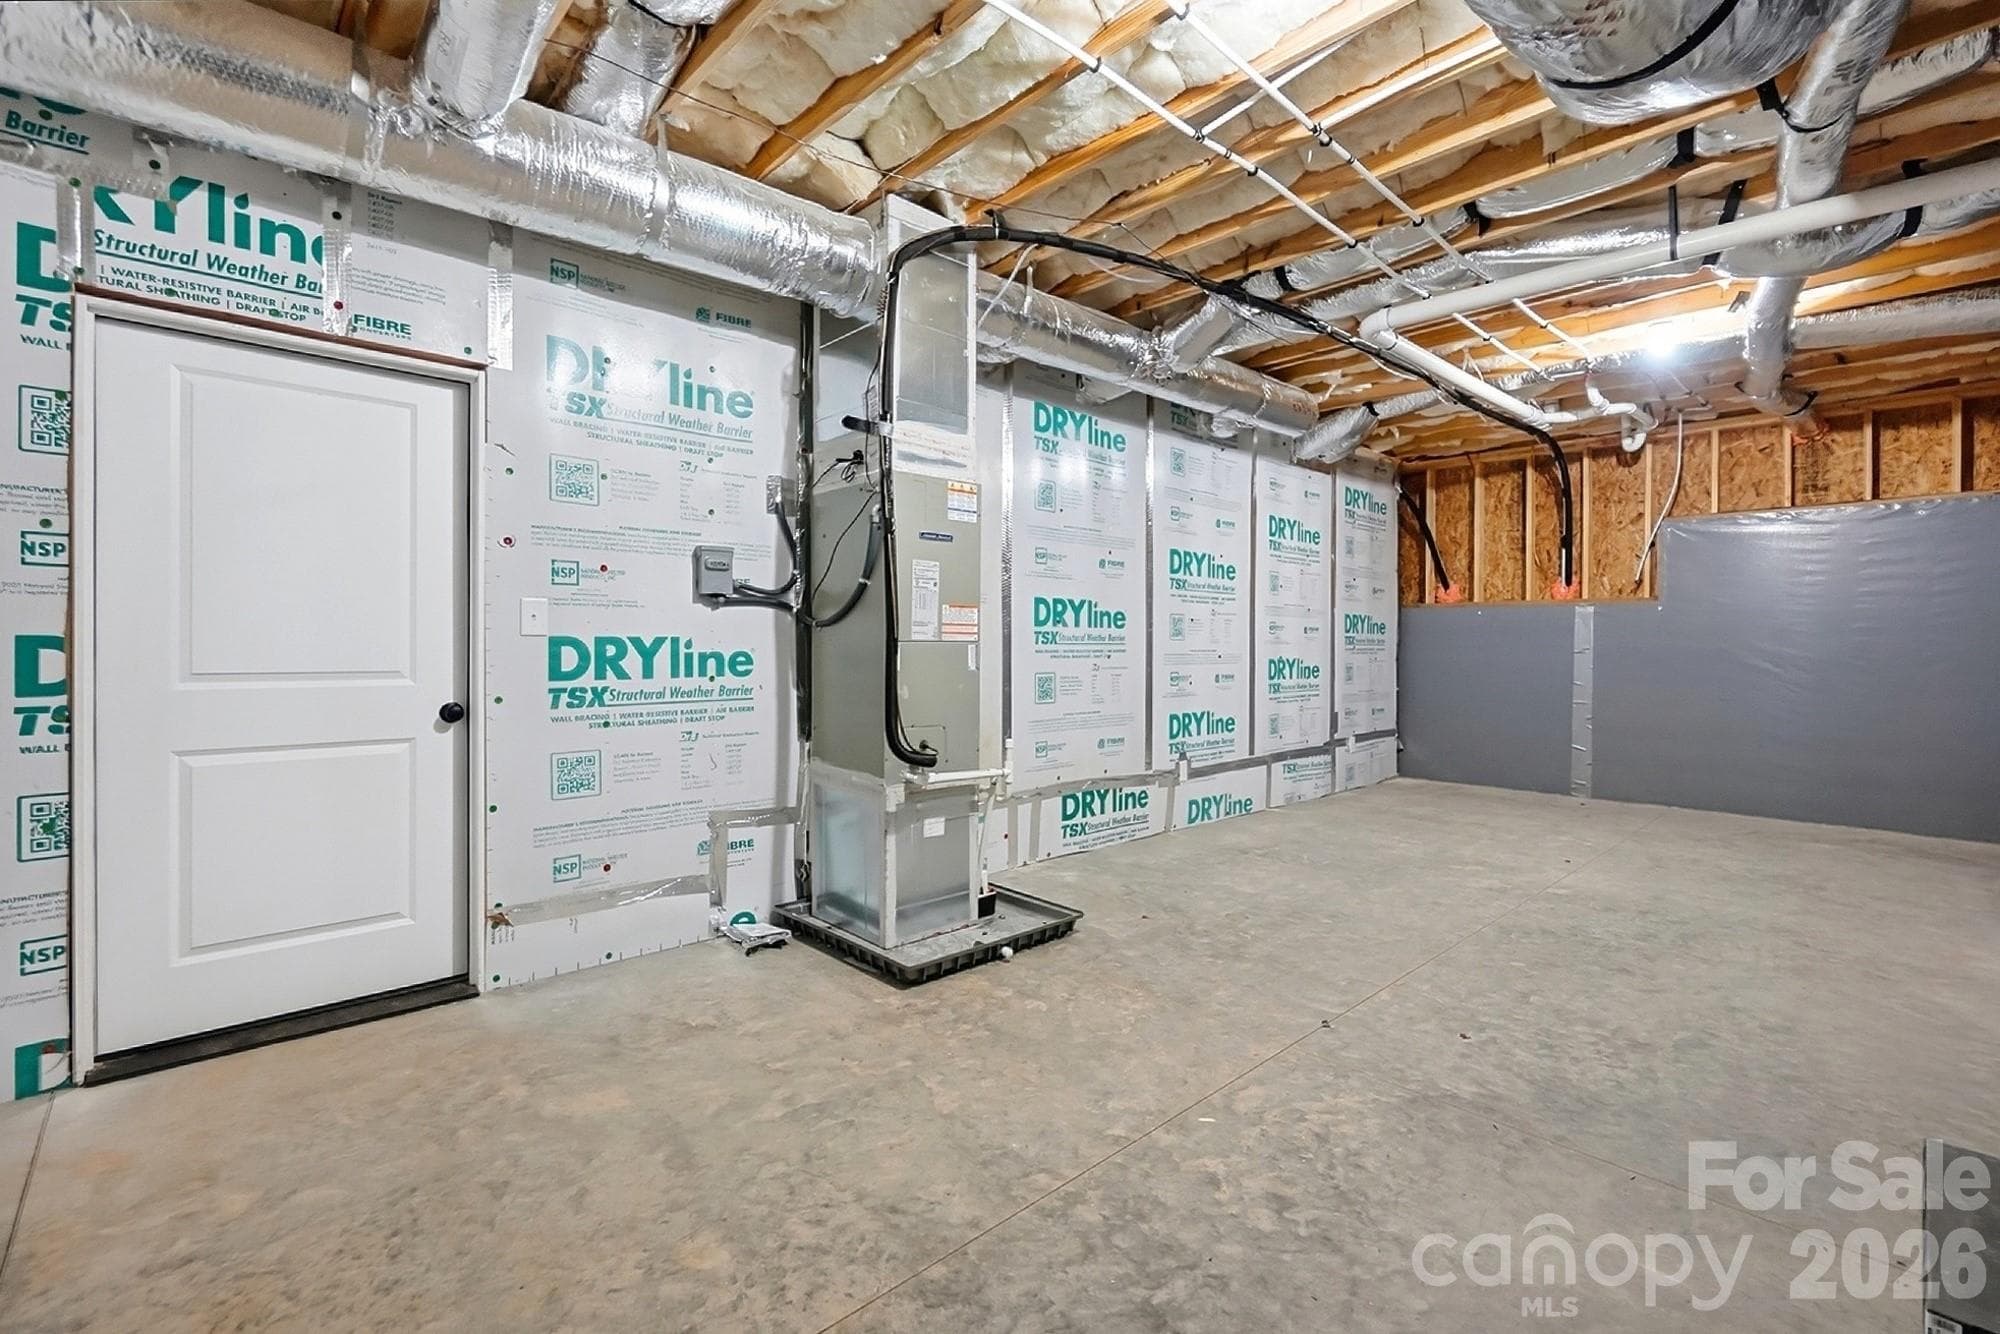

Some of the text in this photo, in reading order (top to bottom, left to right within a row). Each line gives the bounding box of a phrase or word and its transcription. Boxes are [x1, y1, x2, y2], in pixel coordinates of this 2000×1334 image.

[5, 109, 91, 148] Barrier
[95, 229, 199, 267] Structural
[207, 251, 289, 286] Weather
[550, 264, 576, 282] NSP
[111, 266, 309, 314] WATER-RESISTIVE BARRIER AIR
[353, 313, 412, 336] FIBRE
[20, 334, 62, 350] WALL
[667, 411, 714, 435] Weather
[716, 421, 754, 440] Barrier
[1033, 400, 1127, 453] DRYline
[1033, 436, 1060, 455] TSX
[1344, 485, 1388, 516] DRYline
[1268, 514, 1321, 546] DRYline
[20, 540, 67, 557] NSP
[551, 566, 576, 579] NSP
[1169, 548, 1237, 581] DRYline
[1169, 577, 1188, 591] TSX
[1033, 596, 1127, 630] DRYline
[1344, 613, 1387, 636] DRYline
[1033, 630, 1059, 646] TSX
[547, 635, 755, 682] DRYline
[1268, 656, 1320, 681] DRYline
[547, 684, 755, 710] TSX Structural Weather Barrier
[550, 714, 573, 724] WALL
[707, 713, 726, 723] STOP
[1168, 710, 1236, 740] DRYline
[1061, 787, 1149, 822] DRYline
[1187, 793, 1254, 825] DRYline
[1061, 821, 1089, 840] TSX
[553, 862, 578, 876] NSP
[20, 945, 66, 966] NSP
